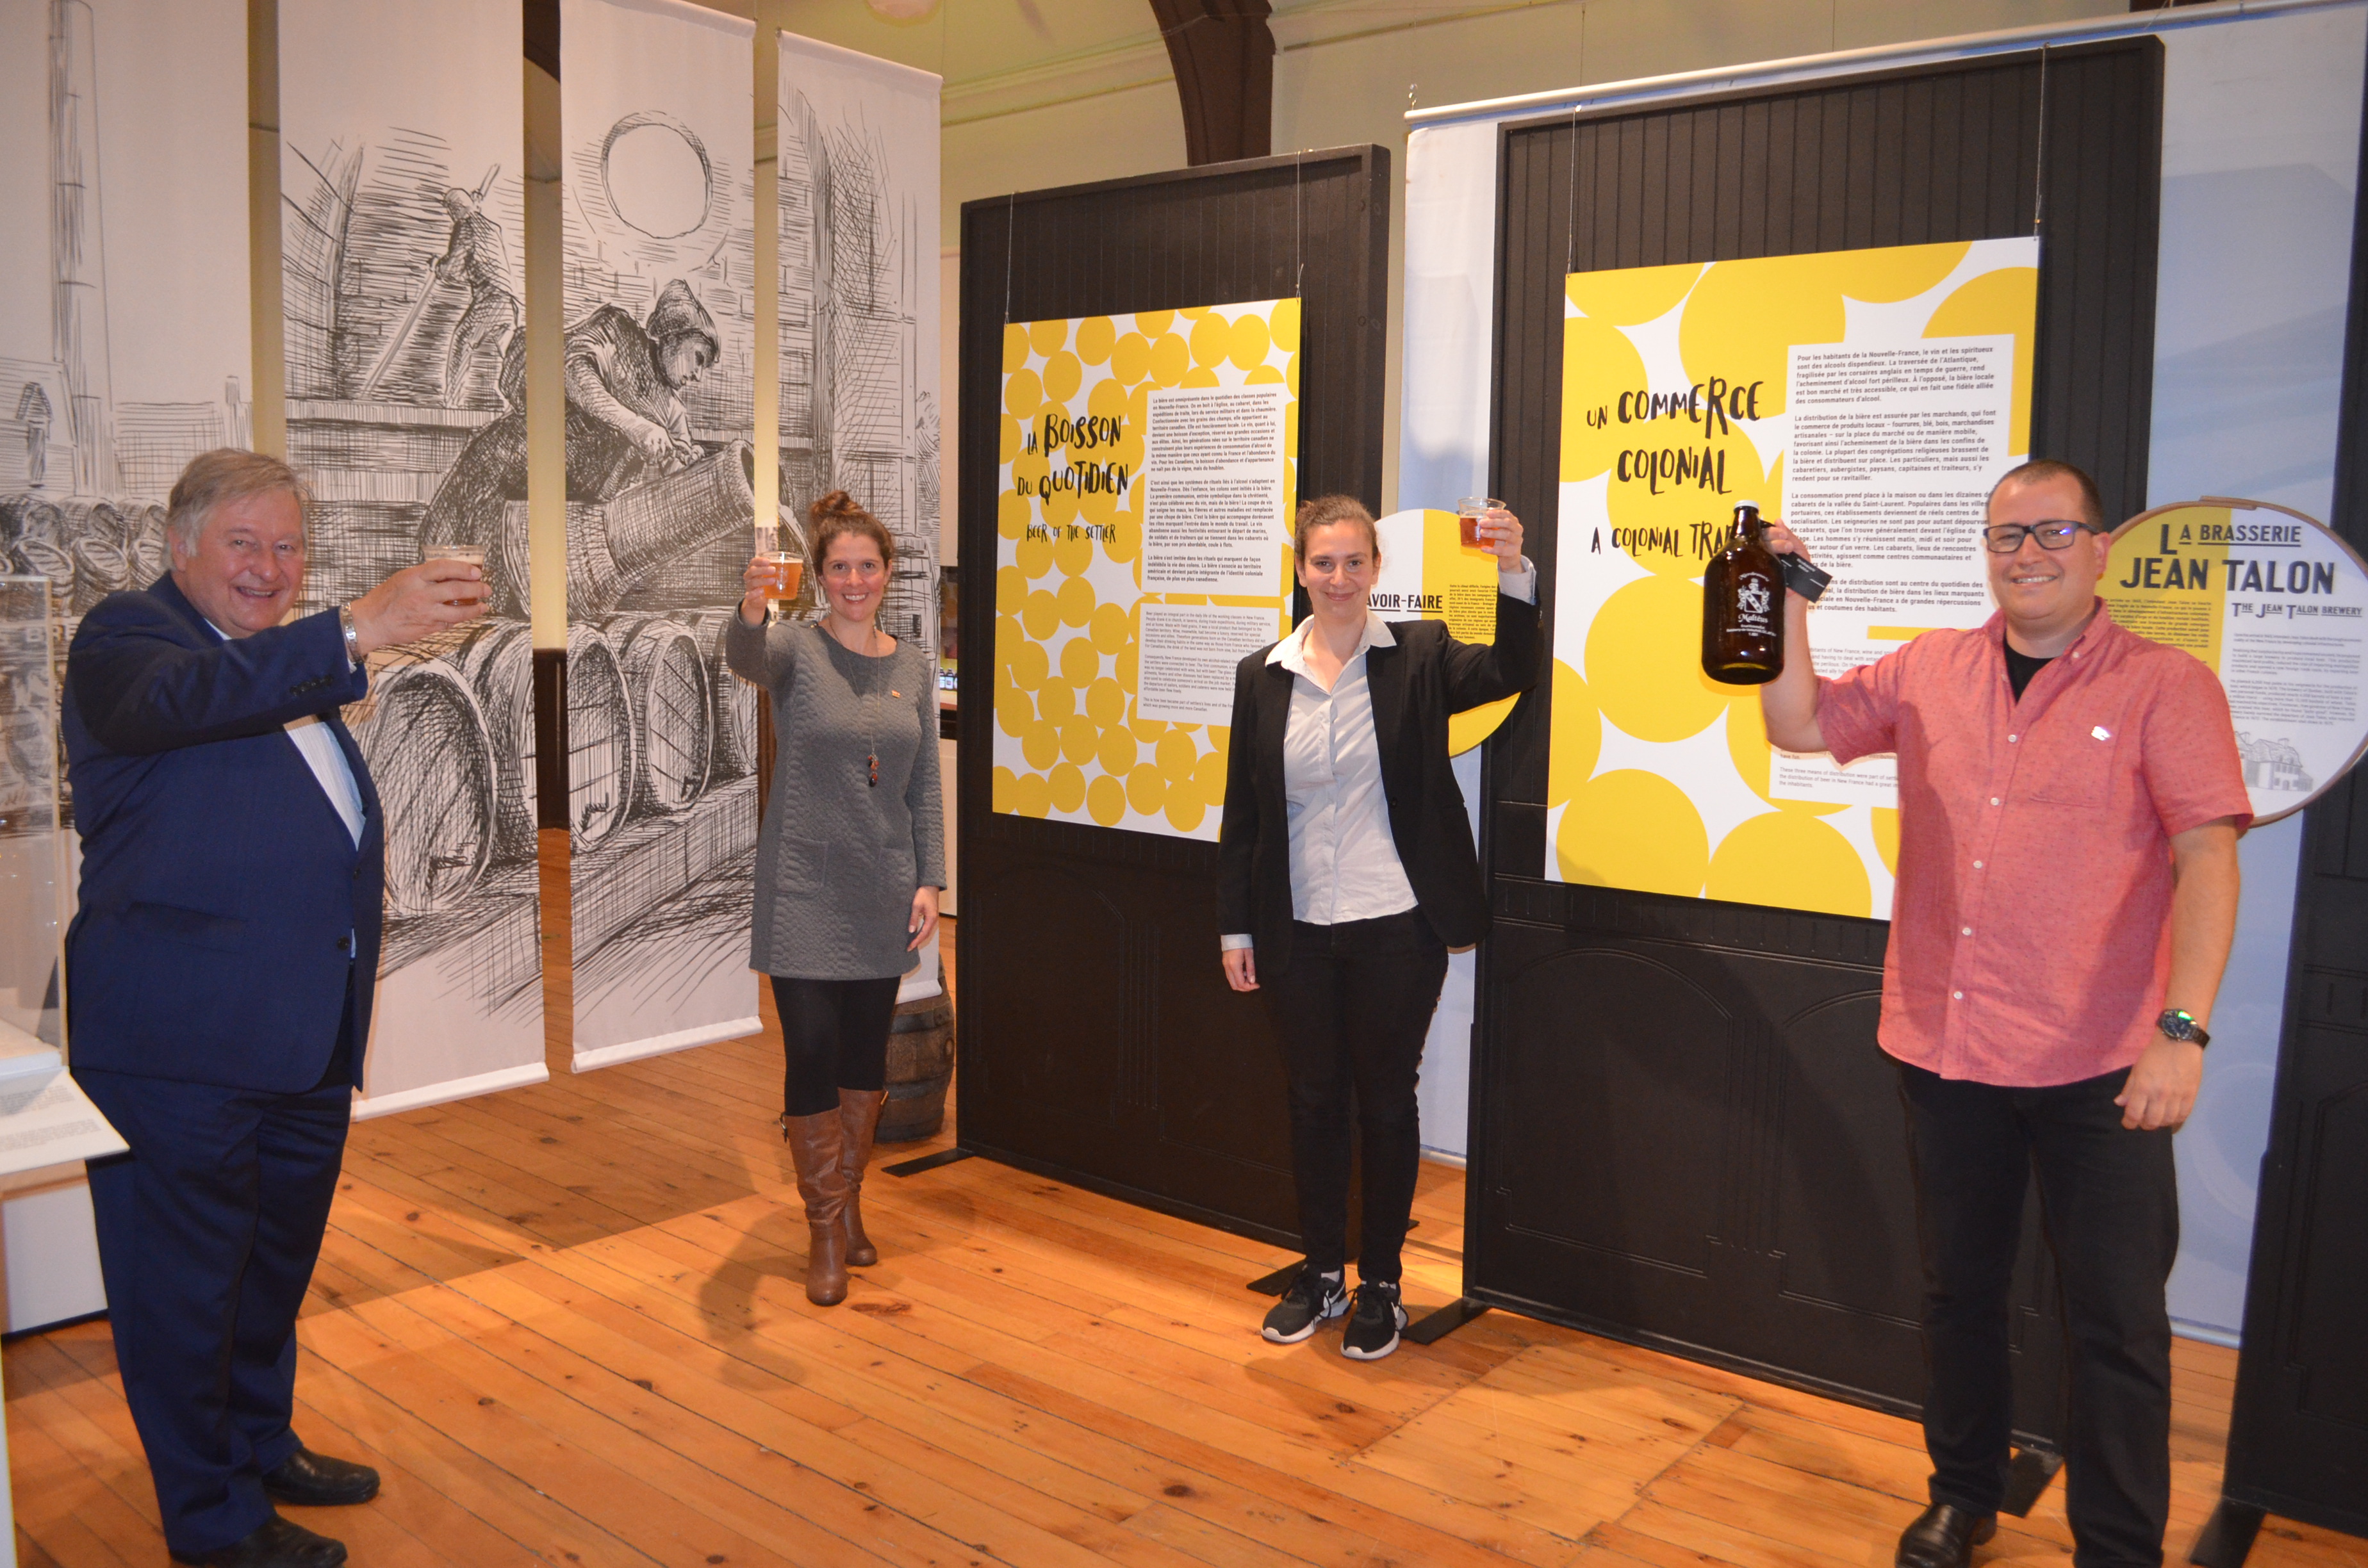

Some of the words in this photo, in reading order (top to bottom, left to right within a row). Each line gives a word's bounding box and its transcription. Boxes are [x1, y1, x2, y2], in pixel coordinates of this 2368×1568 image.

[1868, 348, 1920, 358] Nouvelle-France,
[1961, 345, 1993, 354] spiritueux
[1847, 359, 1887, 368] dispendieux.
[1939, 355, 1978, 364] l'Atlantique,
[1797, 370, 1825, 379] fragilisée
[1879, 367, 1902, 376] anglais
[1913, 366, 1933, 375] temps
[1882, 376, 1910, 384] périlleux.
[1919, 375, 1946, 383] l'opposé,
[1864, 385, 1898, 393] accessible,
[1587, 405, 1607, 429] UN
[1618, 376, 1763, 439] COMMERCE
[1028, 431, 1038, 455] LA
[1044, 414, 1121, 457] BOISSON
[1618, 446, 1732, 495] COLONIAL
[1017, 477, 1032, 496] DU
[1039, 461, 1128, 505] QUOTIDIEN
[1026, 523, 1047, 543] BEER
[1053, 526, 1061, 537] OF
[1067, 525, 1079, 542] THE
[1085, 524, 1115, 543] SETTLER
[2199, 525, 2301, 544] BRASSERIE
[1591, 527, 1600, 555] A
[1612, 527, 1683, 557] COLONIAL
[2119, 557, 2208, 590] JEAN
[2221, 560, 2334, 594] TALON
[1367, 593, 1443, 609] AVOIR-FAIRE
[1951, 589, 1984, 598] marquants
[2231, 603, 2253, 617] THE
[2255, 603, 2283, 618] JEAN
[2287, 605, 2319, 619] TALON
[2321, 607, 2362, 616] BREWERY
